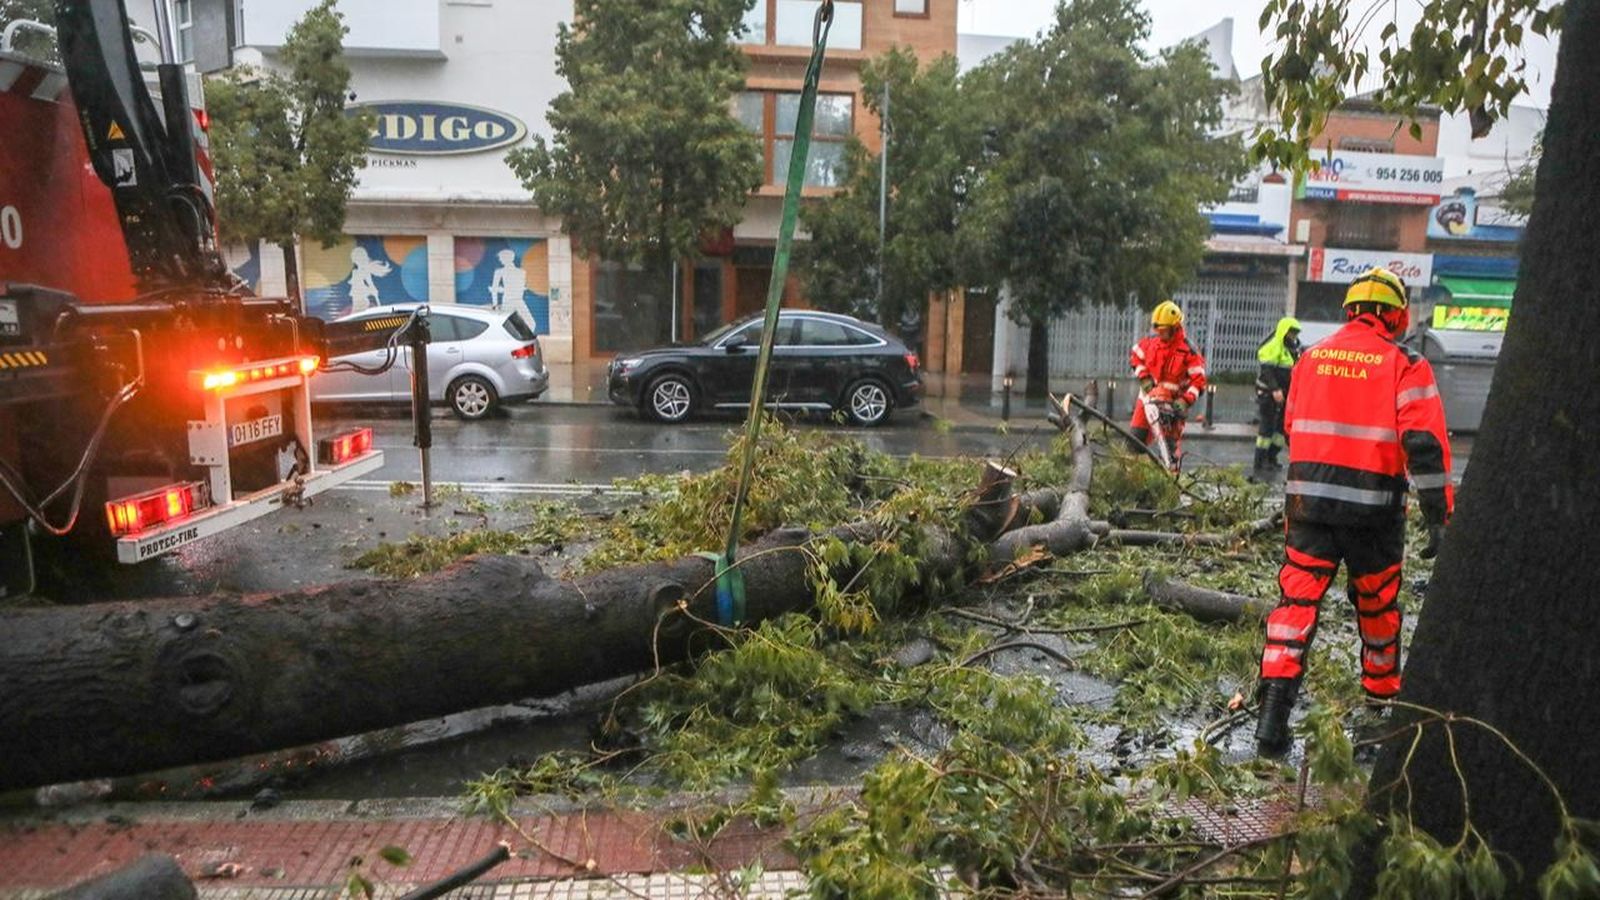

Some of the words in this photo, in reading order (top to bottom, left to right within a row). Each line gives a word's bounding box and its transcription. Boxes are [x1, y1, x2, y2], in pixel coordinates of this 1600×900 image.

[368, 114, 505, 142] DIGO
[371, 159, 417, 168] PICKMAN
[1375, 167, 1397, 181] 954
[1399, 168, 1420, 182] 256
[1422, 169, 1443, 184] 005
[0, 205, 23, 249] 0
[1388, 260, 1421, 278] Reto
[1311, 348, 1383, 366] BOMBEROS
[1316, 363, 1368, 379] SEVILLA
[235, 420, 260, 442] 0116
[262, 415, 280, 436] FFY
[140, 527, 198, 557] PROTEC-FIRE
